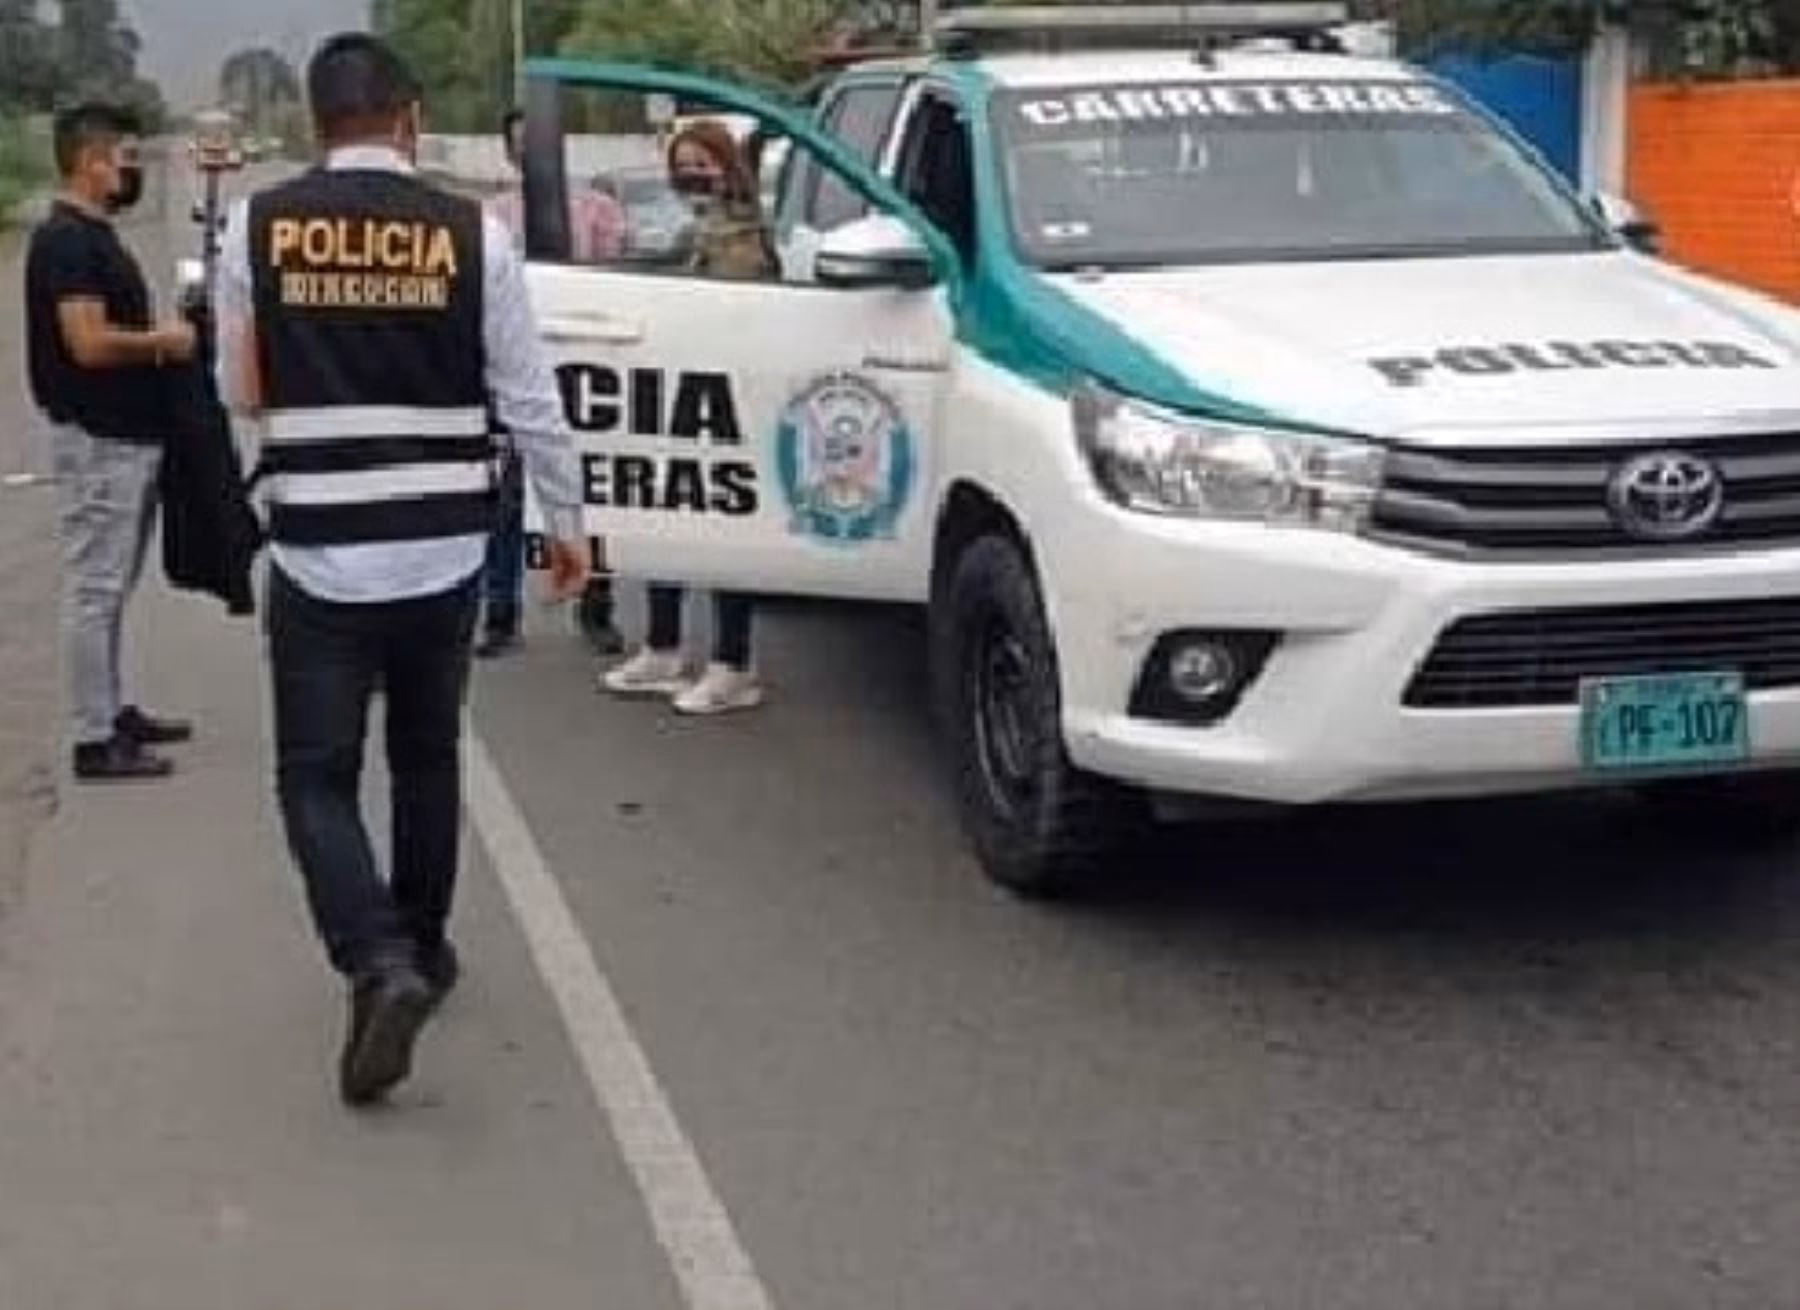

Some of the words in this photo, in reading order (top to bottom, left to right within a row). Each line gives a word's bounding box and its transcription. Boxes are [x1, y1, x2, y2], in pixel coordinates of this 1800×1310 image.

[1020, 84, 1456, 124] CARRETERAS
[270, 217, 457, 275] POLICIA
[1367, 341, 1778, 387] POLICIA
